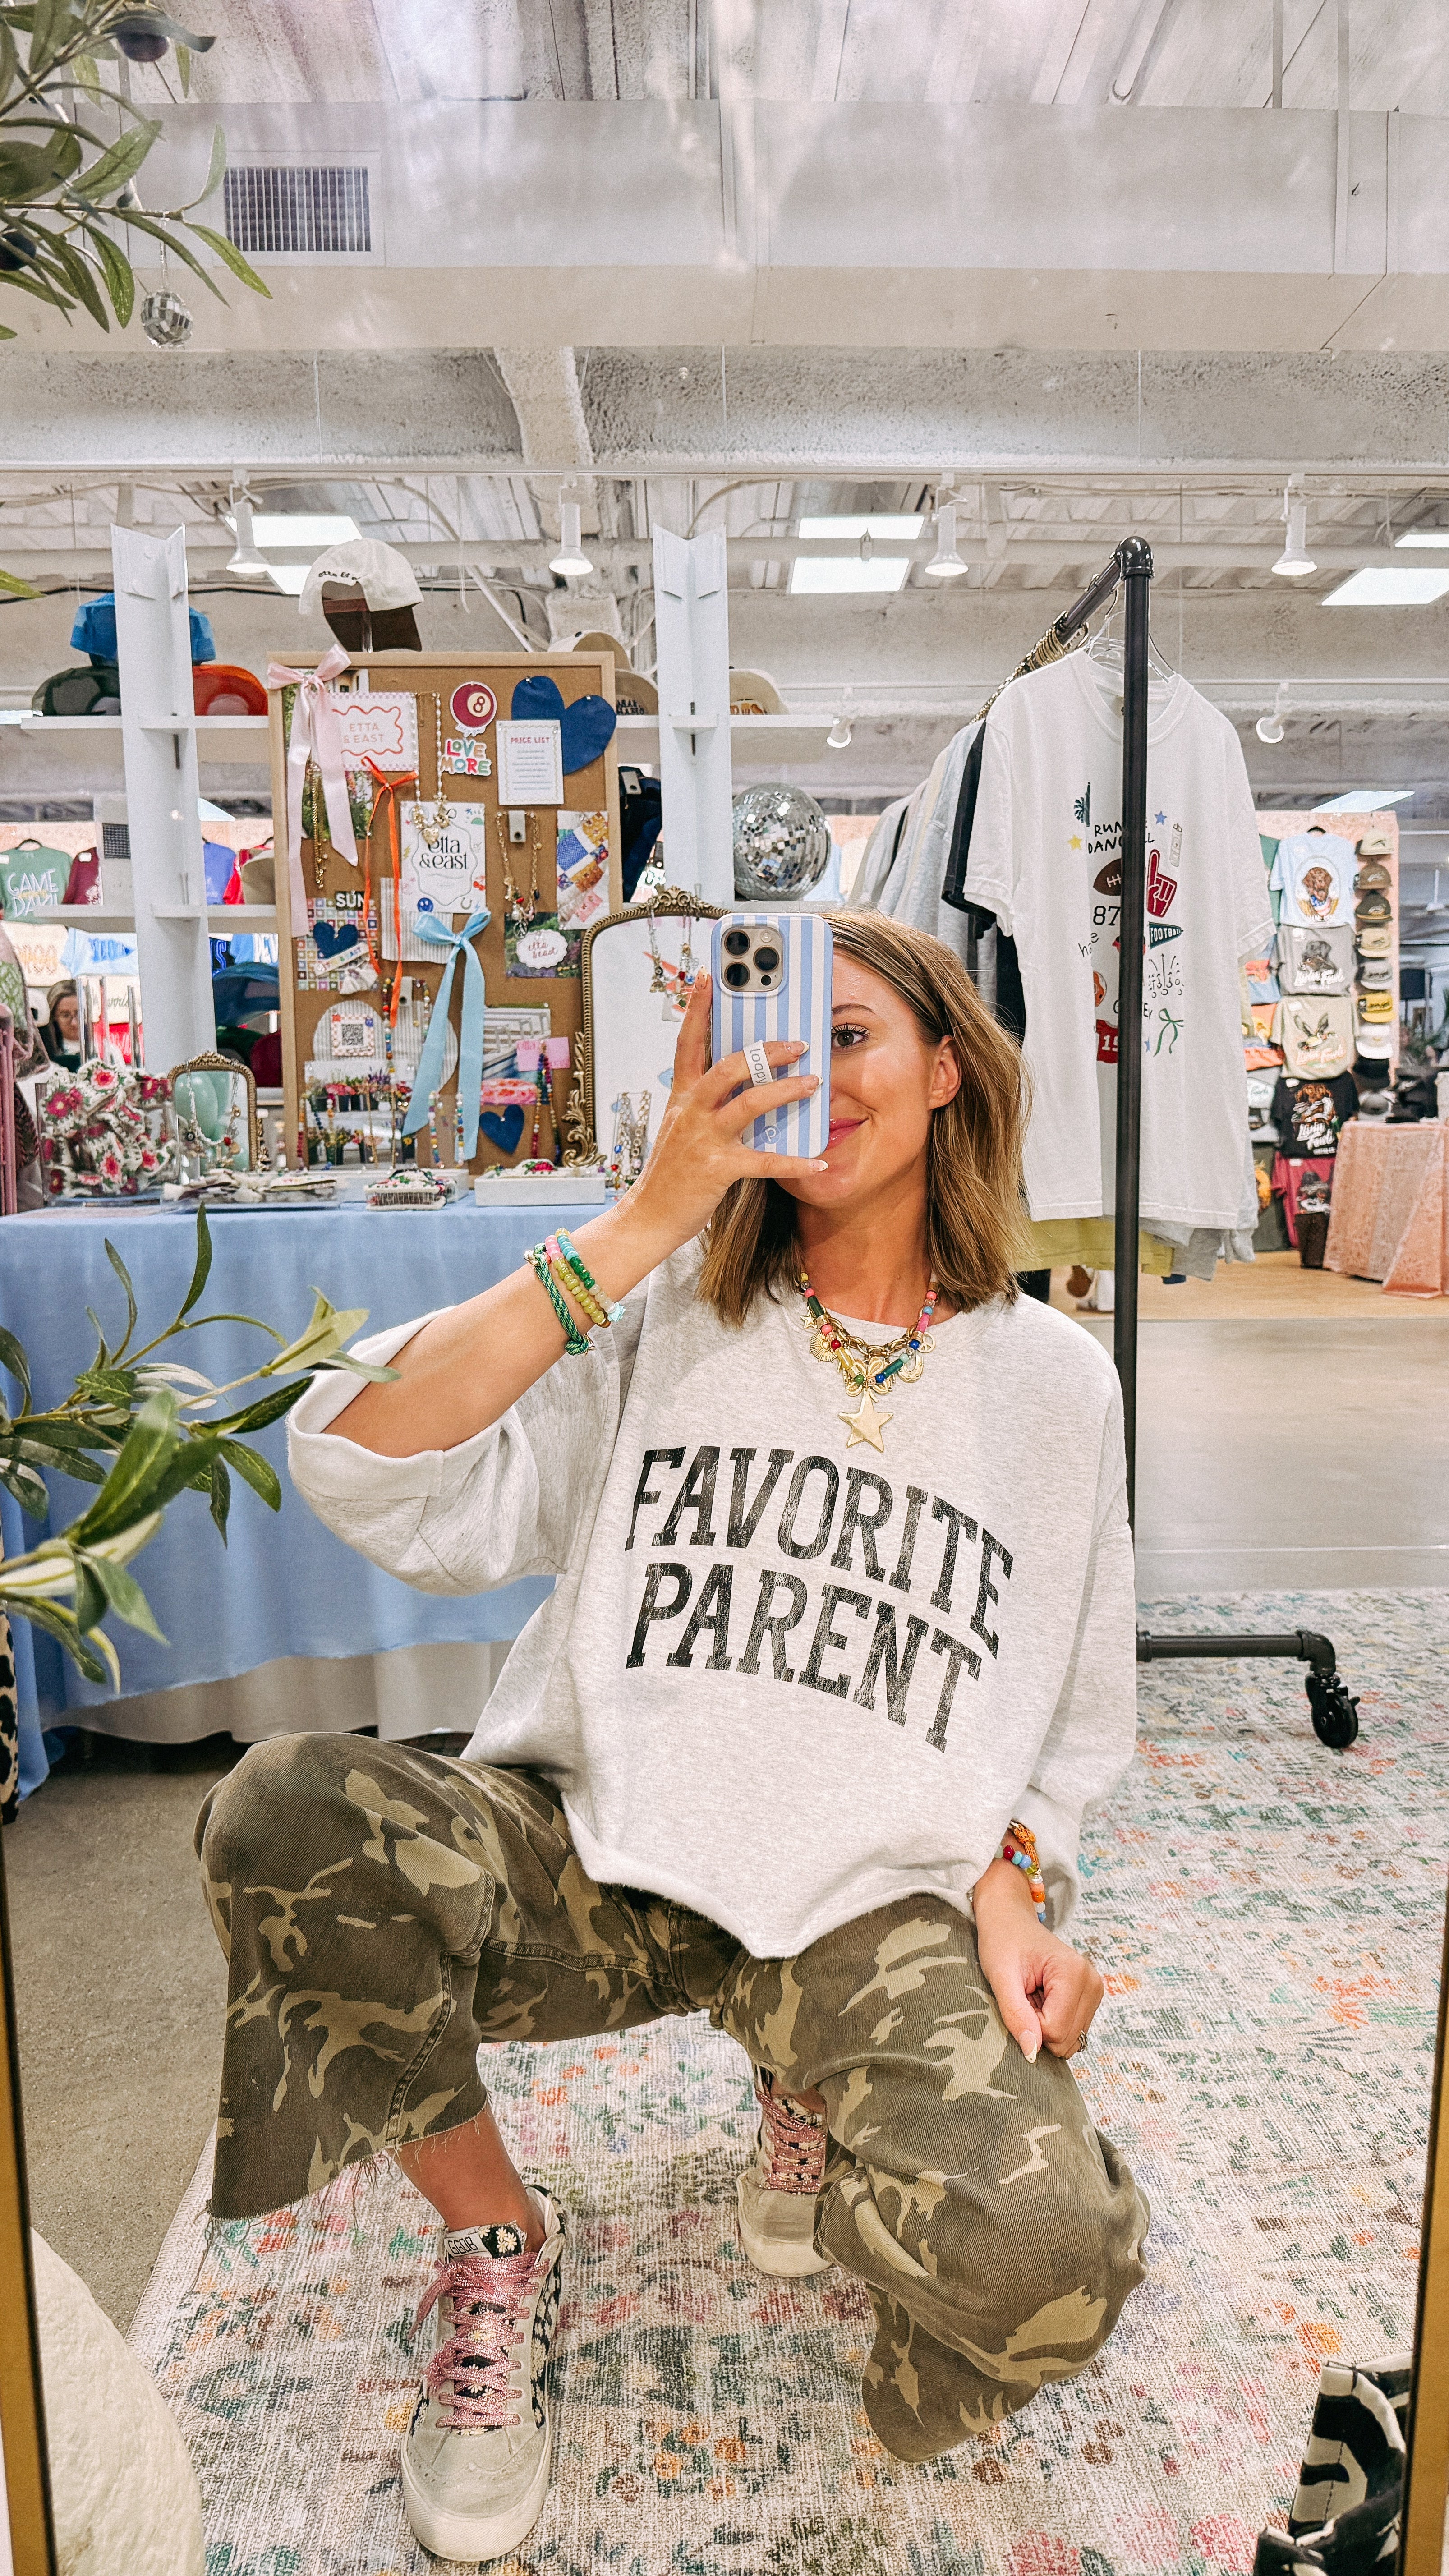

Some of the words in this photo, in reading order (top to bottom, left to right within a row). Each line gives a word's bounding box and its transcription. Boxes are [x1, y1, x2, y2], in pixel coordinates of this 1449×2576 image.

[474, 696, 485, 713] 8
[350, 723, 379, 732] ETTA
[354, 734, 383, 743] EAST
[447, 739, 484, 759] LOVE
[441, 756, 489, 774] MORE
[1088, 836, 1122, 854] DANC
[7, 868, 59, 896] GAME
[1092, 905, 1121, 926] 87
[750, 1048, 768, 1083] loopy
[625, 1445, 1014, 1660] FAVORITE
[626, 1562, 983, 1753] PARENT
